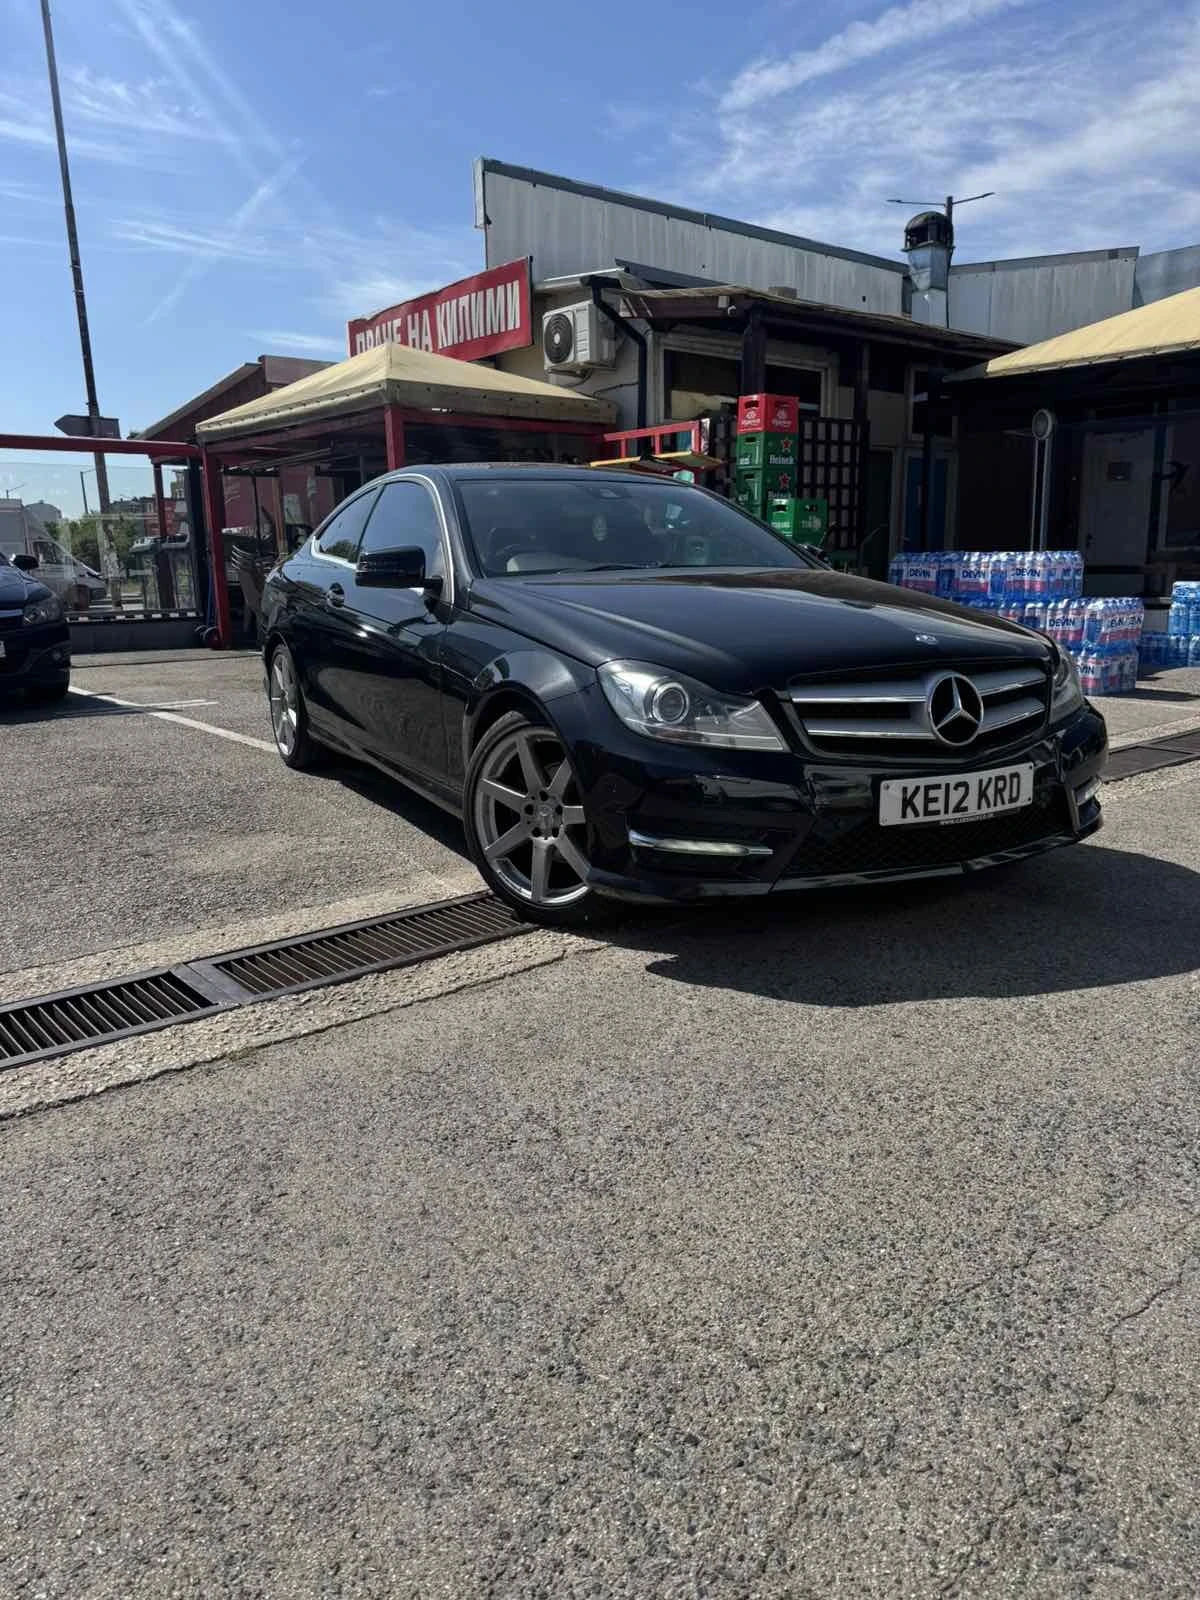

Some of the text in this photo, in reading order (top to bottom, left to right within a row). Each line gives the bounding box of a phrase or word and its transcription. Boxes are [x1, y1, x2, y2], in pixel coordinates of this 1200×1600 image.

[408, 309, 433, 354] НА
[436, 280, 521, 349] КИЛИМИ
[909, 568, 931, 578] DEVIN
[962, 568, 986, 578] DEVIN
[1015, 567, 1041, 577] DEVIN
[1049, 616, 1076, 627] DEVIN
[901, 771, 1021, 819] KE12 KRD
